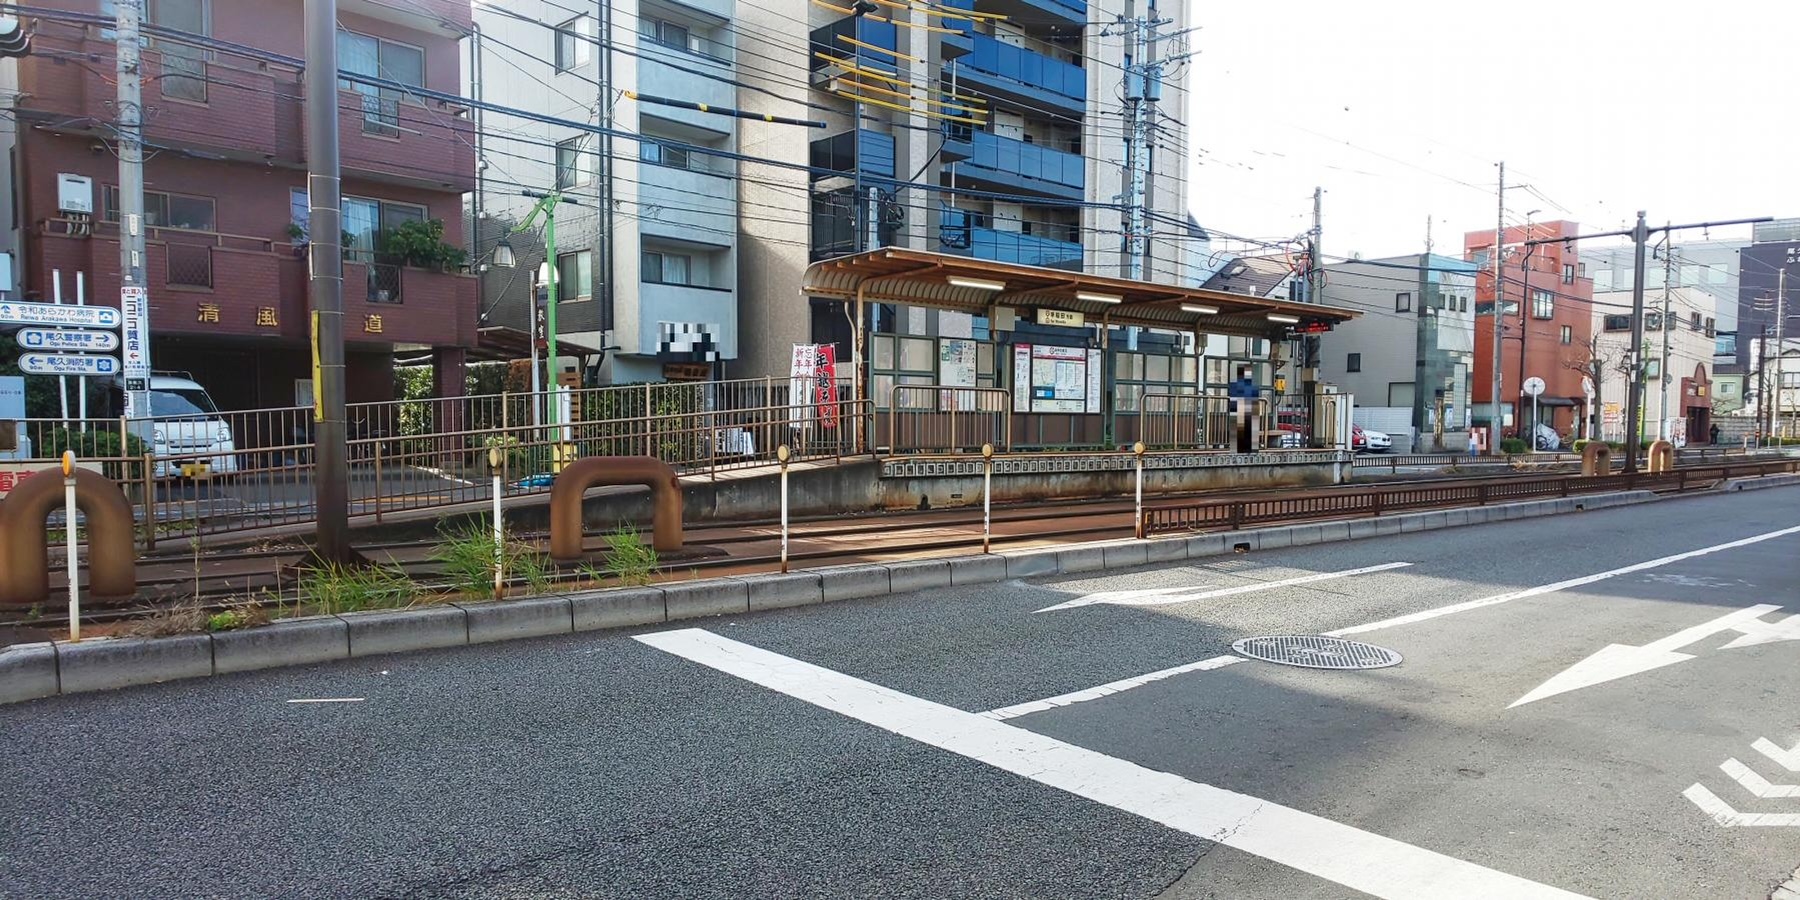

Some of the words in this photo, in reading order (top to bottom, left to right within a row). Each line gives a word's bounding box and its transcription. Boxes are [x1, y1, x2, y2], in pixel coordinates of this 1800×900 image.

[18, 306, 94, 318] 令和あらかわ病院
[126, 295, 139, 351] ニコニコ質店
[45, 332, 92, 342] 尾久警察署
[46, 356, 94, 367] 尾久消防署
